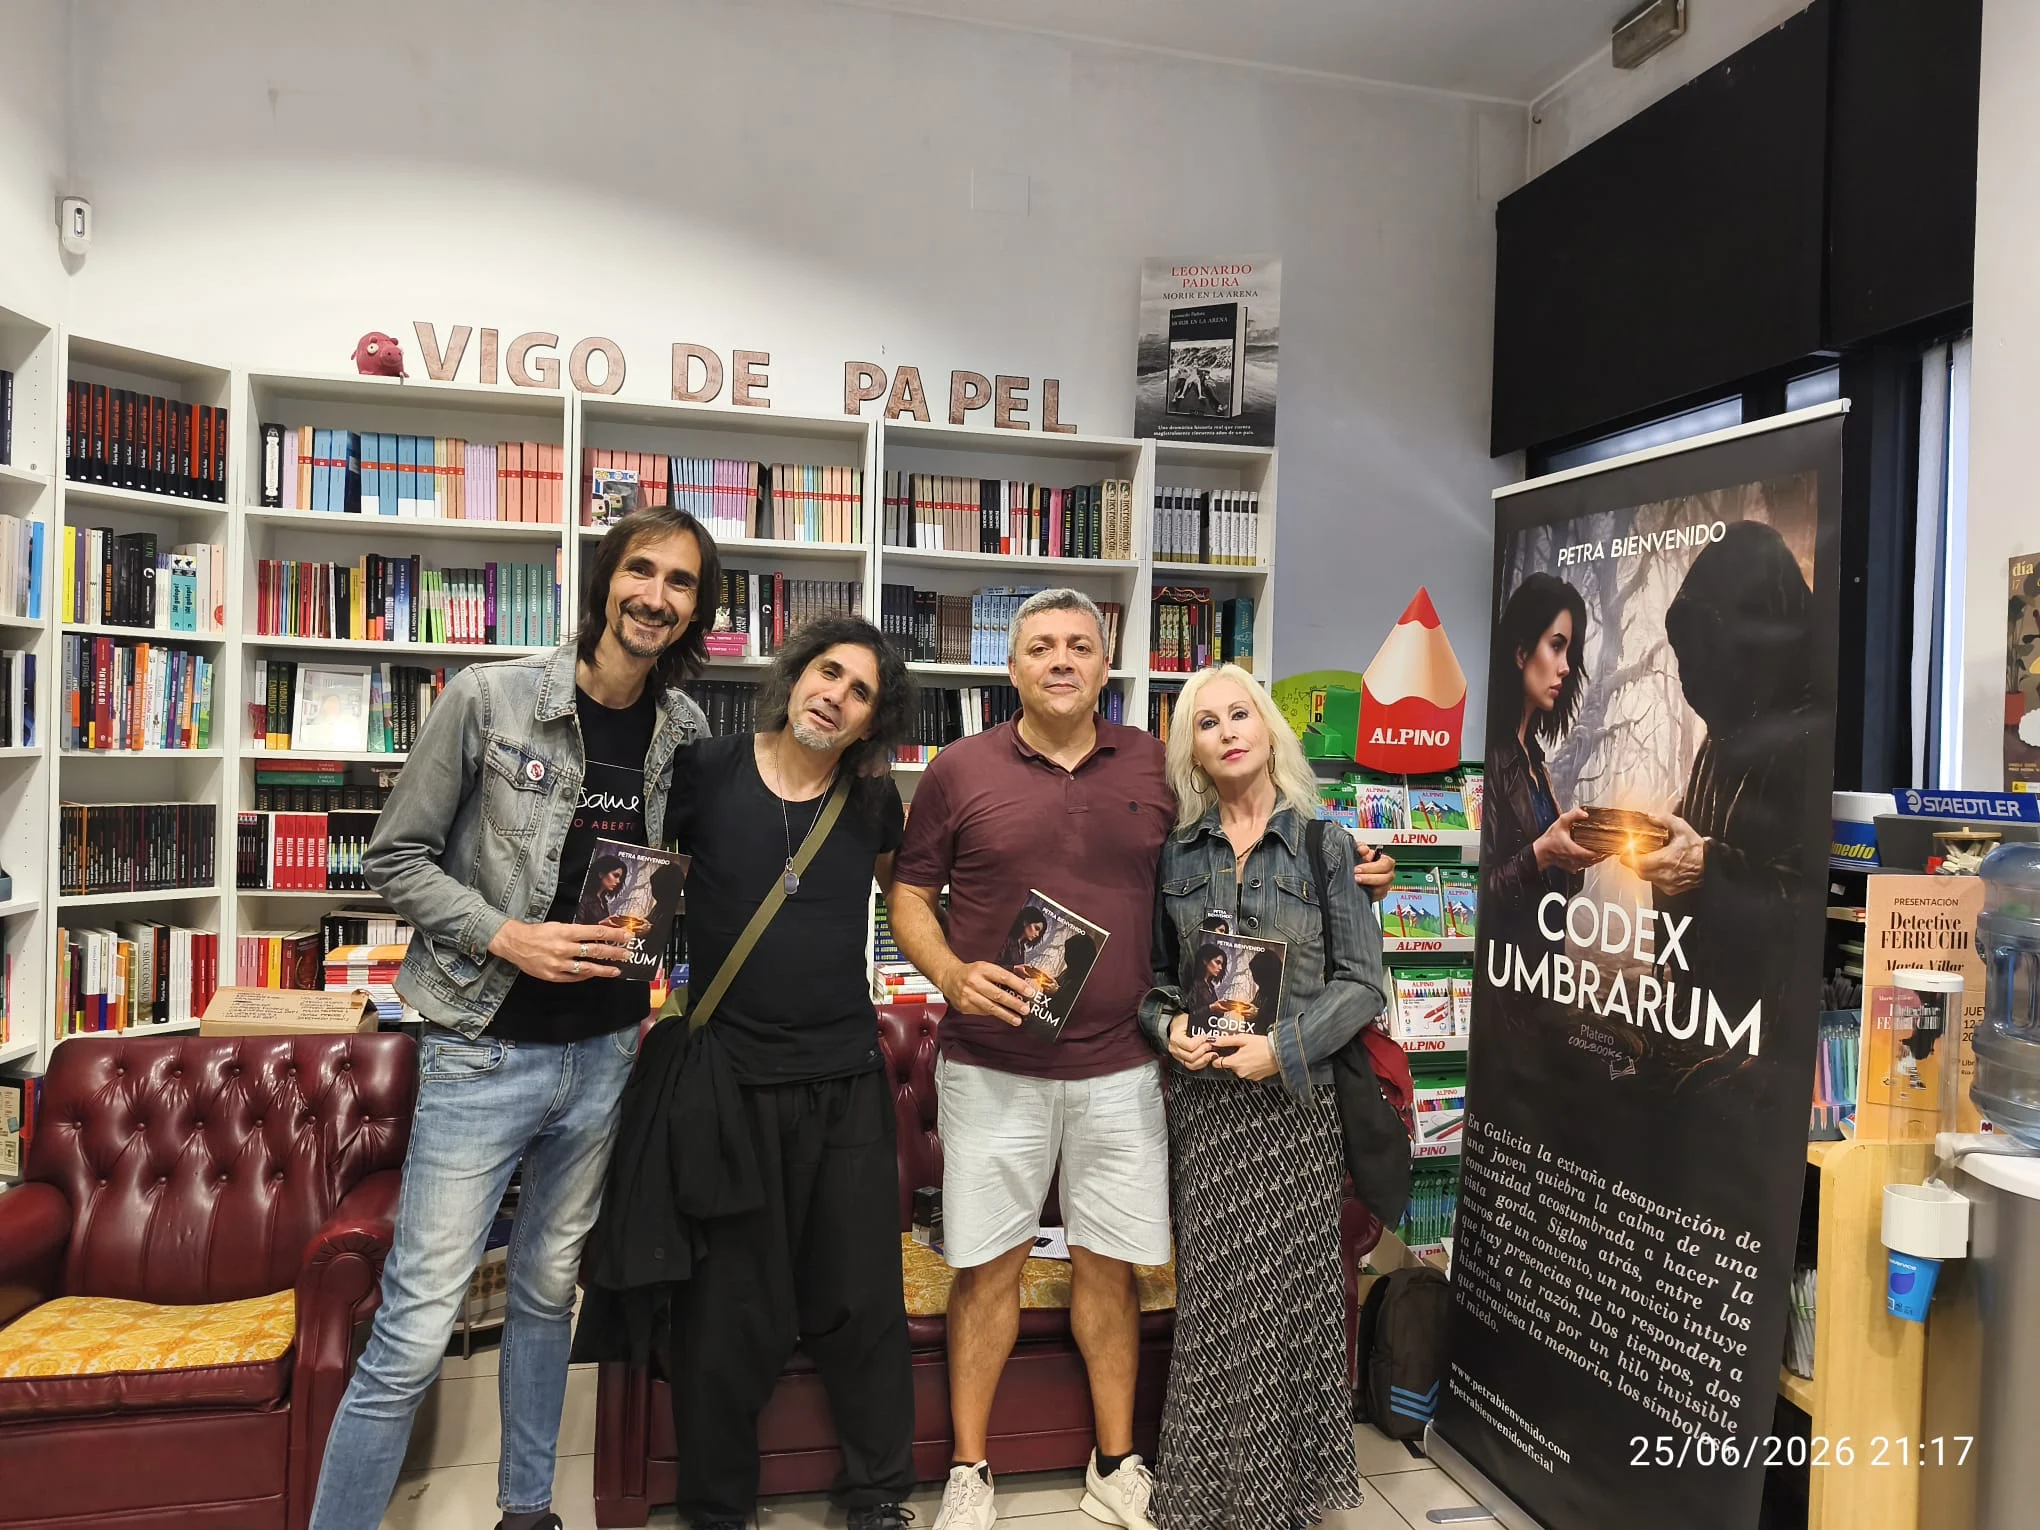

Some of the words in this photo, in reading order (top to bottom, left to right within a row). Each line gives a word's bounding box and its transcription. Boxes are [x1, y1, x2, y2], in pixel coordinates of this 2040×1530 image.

[1171, 264, 1252, 277] LEONARDO
[1182, 277, 1240, 289] PADURA
[1162, 291, 1195, 300] MORIR
[1197, 291, 1210, 299] EN
[1212, 290, 1224, 299] LA
[1225, 289, 1258, 299] ARENA
[413, 321, 627, 395] VIGO
[671, 342, 771, 409] DE
[1557, 541, 1604, 567] PETRA
[1610, 520, 1727, 558] BIENVENIDO
[1368, 727, 1450, 747] ALPINO
[1924, 796, 2022, 817] STAEDTLER
[1391, 834, 1438, 844] ALPINO
[617, 851, 636, 860] PETRA
[636, 854, 670, 865] BIENVENIDO
[1831, 840, 1876, 860] medio
[1041, 907, 1057, 919] PETRA
[1056, 916, 1086, 936] BIENVENIDO
[1537, 891, 1693, 971] CODEX
[1890, 911, 1961, 931] Detective
[1216, 940, 1233, 948] PETRA
[1233, 943, 1266, 953] BIENVENIDO
[1395, 941, 1442, 951] ALPINO
[1880, 931, 1969, 950] FERRUCHI
[1884, 959, 1925, 971] Marta
[1927, 959, 1965, 972] Villar
[1411, 980, 1434, 988] ALPINO
[1488, 939, 1762, 1057] UMBRARUM
[1207, 1015, 1256, 1034] CODEX
[1580, 1023, 1615, 1046] Platero
[1963, 1019, 1975, 1029] 12
[1401, 1040, 1446, 1051] ALPINO
[1962, 1032, 1973, 1042] 20
[1414, 1145, 1447, 1157] PINO
[1467, 1112, 1480, 1132] En
[1484, 1122, 1532, 1155] Galicia
[1537, 1143, 1552, 1163] la
[1557, 1157, 1606, 1190] extraña
[1611, 1180, 1726, 1241] desaparición
[1735, 1231, 1761, 1254] de
[1466, 1136, 1485, 1155] una
[1489, 1146, 1526, 1174] joven
[1535, 1170, 1586, 1203] quiebra
[1594, 1193, 1608, 1215] la
[1618, 1210, 1665, 1243] calma
[1676, 1235, 1701, 1257] de
[1714, 1253, 1758, 1280] una
[1465, 1156, 1532, 1197] comunidad
[1538, 1193, 1635, 1252] acostumbrada
[1644, 1248, 1654, 1261] a
[1663, 1251, 1719, 1289] hacer
[1731, 1280, 1754, 1305] la
[1464, 1174, 1487, 1197] vista
[1547, 1216, 1588, 1251] Siglos
[1598, 1249, 1643, 1283] atrás,
[1655, 1279, 1703, 1310] entre
[1719, 1303, 1752, 1331] los
[1463, 1194, 1493, 1222] muros
[1495, 1212, 1512, 1231] de
[1514, 1224, 1530, 1242] un
[1531, 1235, 1593, 1280] convento,
[1597, 1271, 1617, 1291] un
[1620, 1283, 1679, 1324] novicio
[1683, 1313, 1748, 1357] intuye
[1461, 1214, 1478, 1233] que
[1479, 1223, 1502, 1249] hay
[1503, 1242, 1572, 1289] presencias
[1575, 1284, 1602, 1306] que
[1606, 1300, 1626, 1319] no
[1631, 1314, 1722, 1373] responden
[1729, 1367, 1743, 1383] a
[1456, 1291, 1466, 1305] el
[1466, 1300, 1499, 1333] miedo.
[1460, 1229, 1470, 1248] la
[1473, 1240, 1483, 1257] fe
[1486, 1253, 1501, 1269] ni
[1504, 1265, 1514, 1277] a
[1519, 1269, 1532, 1289] la
[1538, 1285, 1581, 1319] razón.
[1589, 1310, 1619, 1339] Dos
[1626, 1333, 1694, 1387] tiempos,
[1705, 1379, 1741, 1409] dos
[1457, 1272, 1476, 1293] que
[1475, 1287, 1526, 1331] atraviesa
[1528, 1320, 1543, 1342] la
[1544, 1335, 1613, 1388] memoria,
[1617, 1374, 1641, 1402] los
[1458, 1248, 1502, 1292] historias
[1506, 1288, 1551, 1323] unidas
[1555, 1319, 1583, 1340] por
[1589, 1338, 1609, 1358] un
[1617, 1350, 1649, 1382] hilo
[1657, 1375, 1738, 1434] invisible
[1451, 1361, 1571, 1464] www.petrabienvenido.com
[1449, 1378, 1555, 1474] #petrabienvenidooficial
